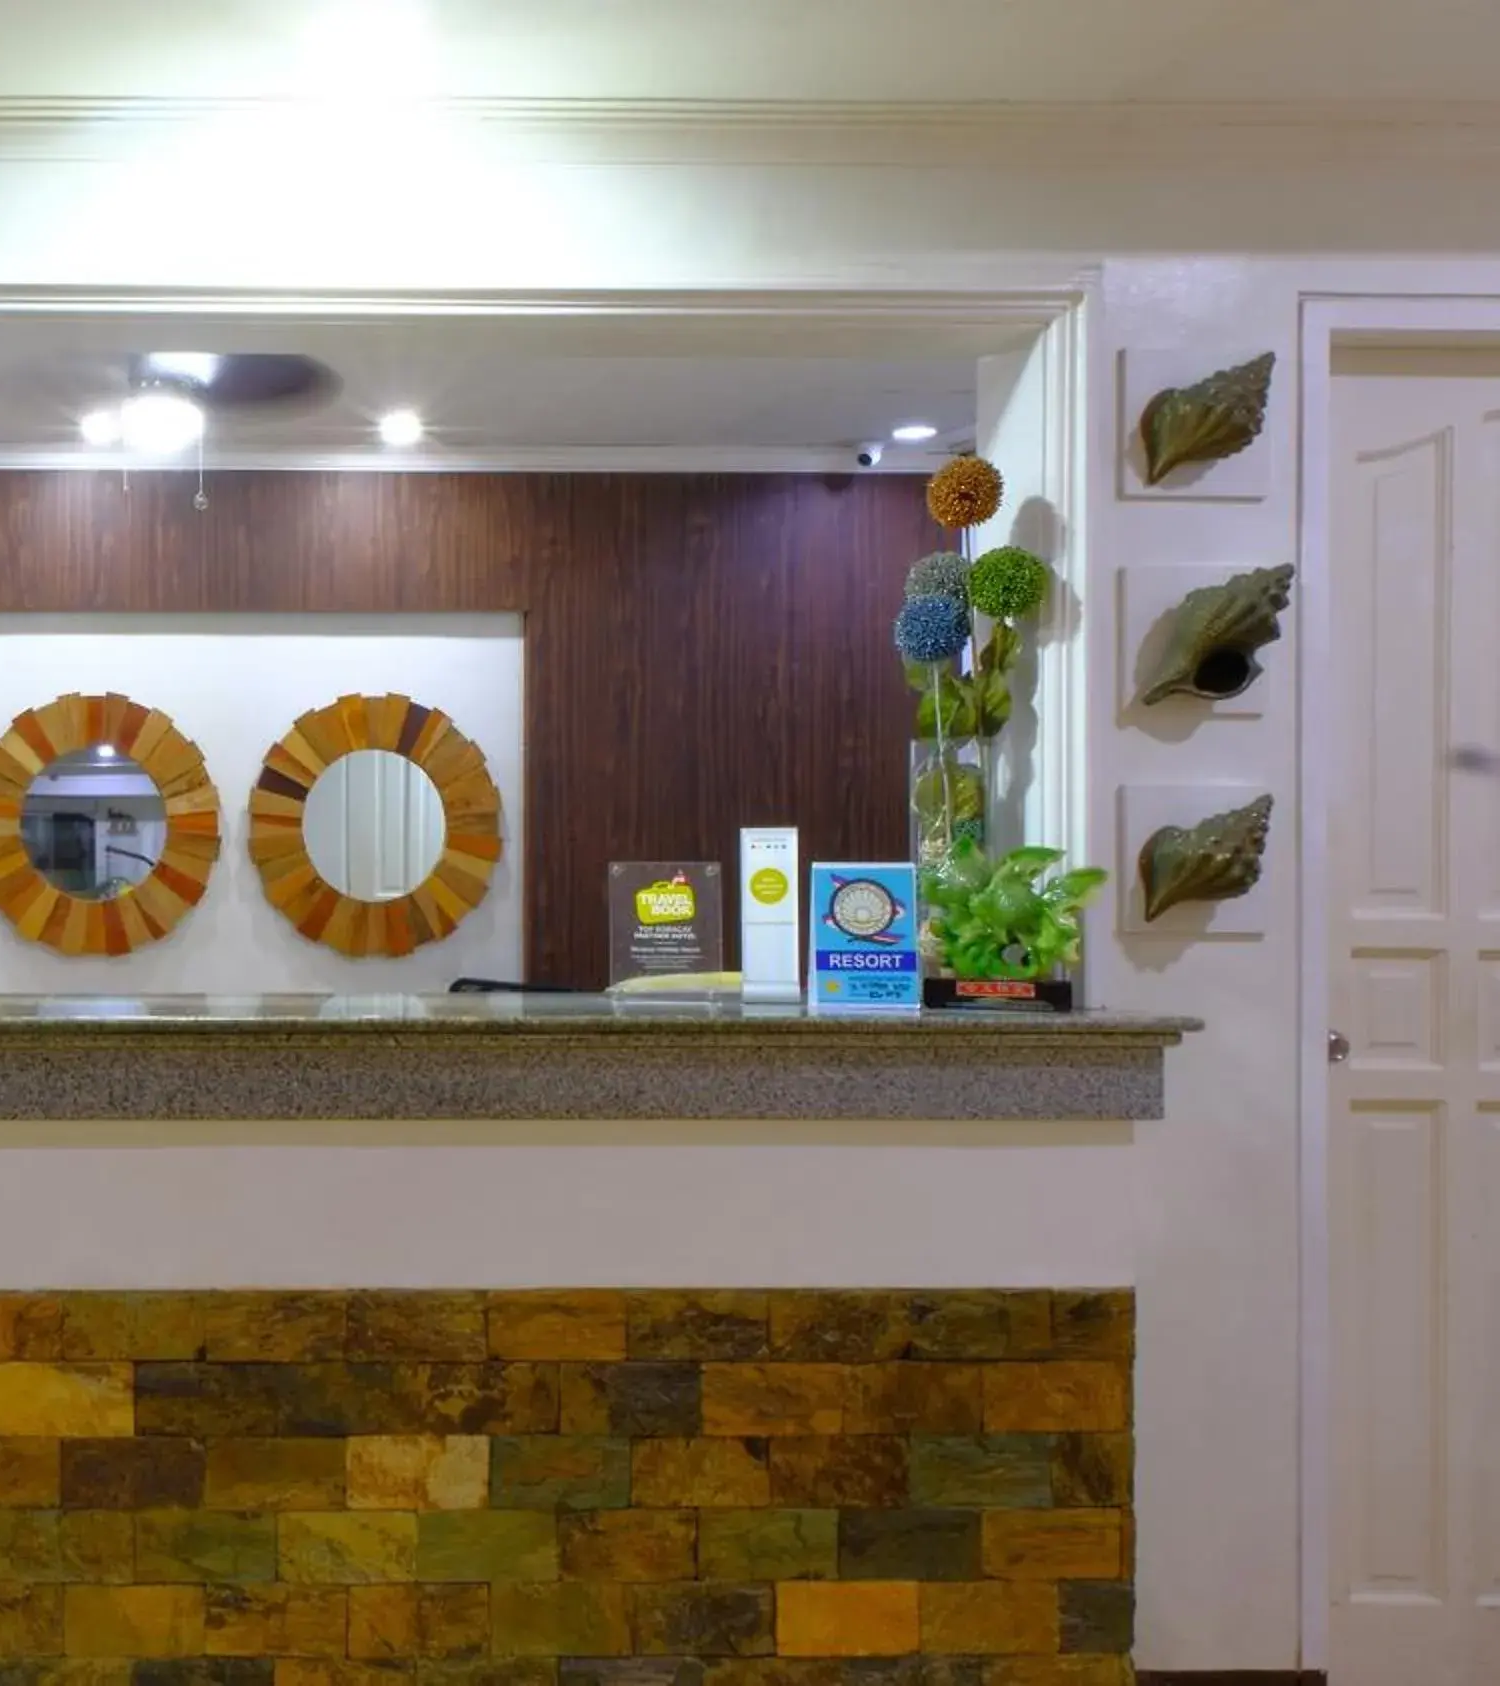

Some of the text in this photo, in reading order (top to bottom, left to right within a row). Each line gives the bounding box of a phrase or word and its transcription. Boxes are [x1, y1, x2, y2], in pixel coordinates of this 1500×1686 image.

[638, 892, 691, 905] TRAVEL
[651, 904, 693, 917] BOOK
[828, 953, 904, 969] RESORT
